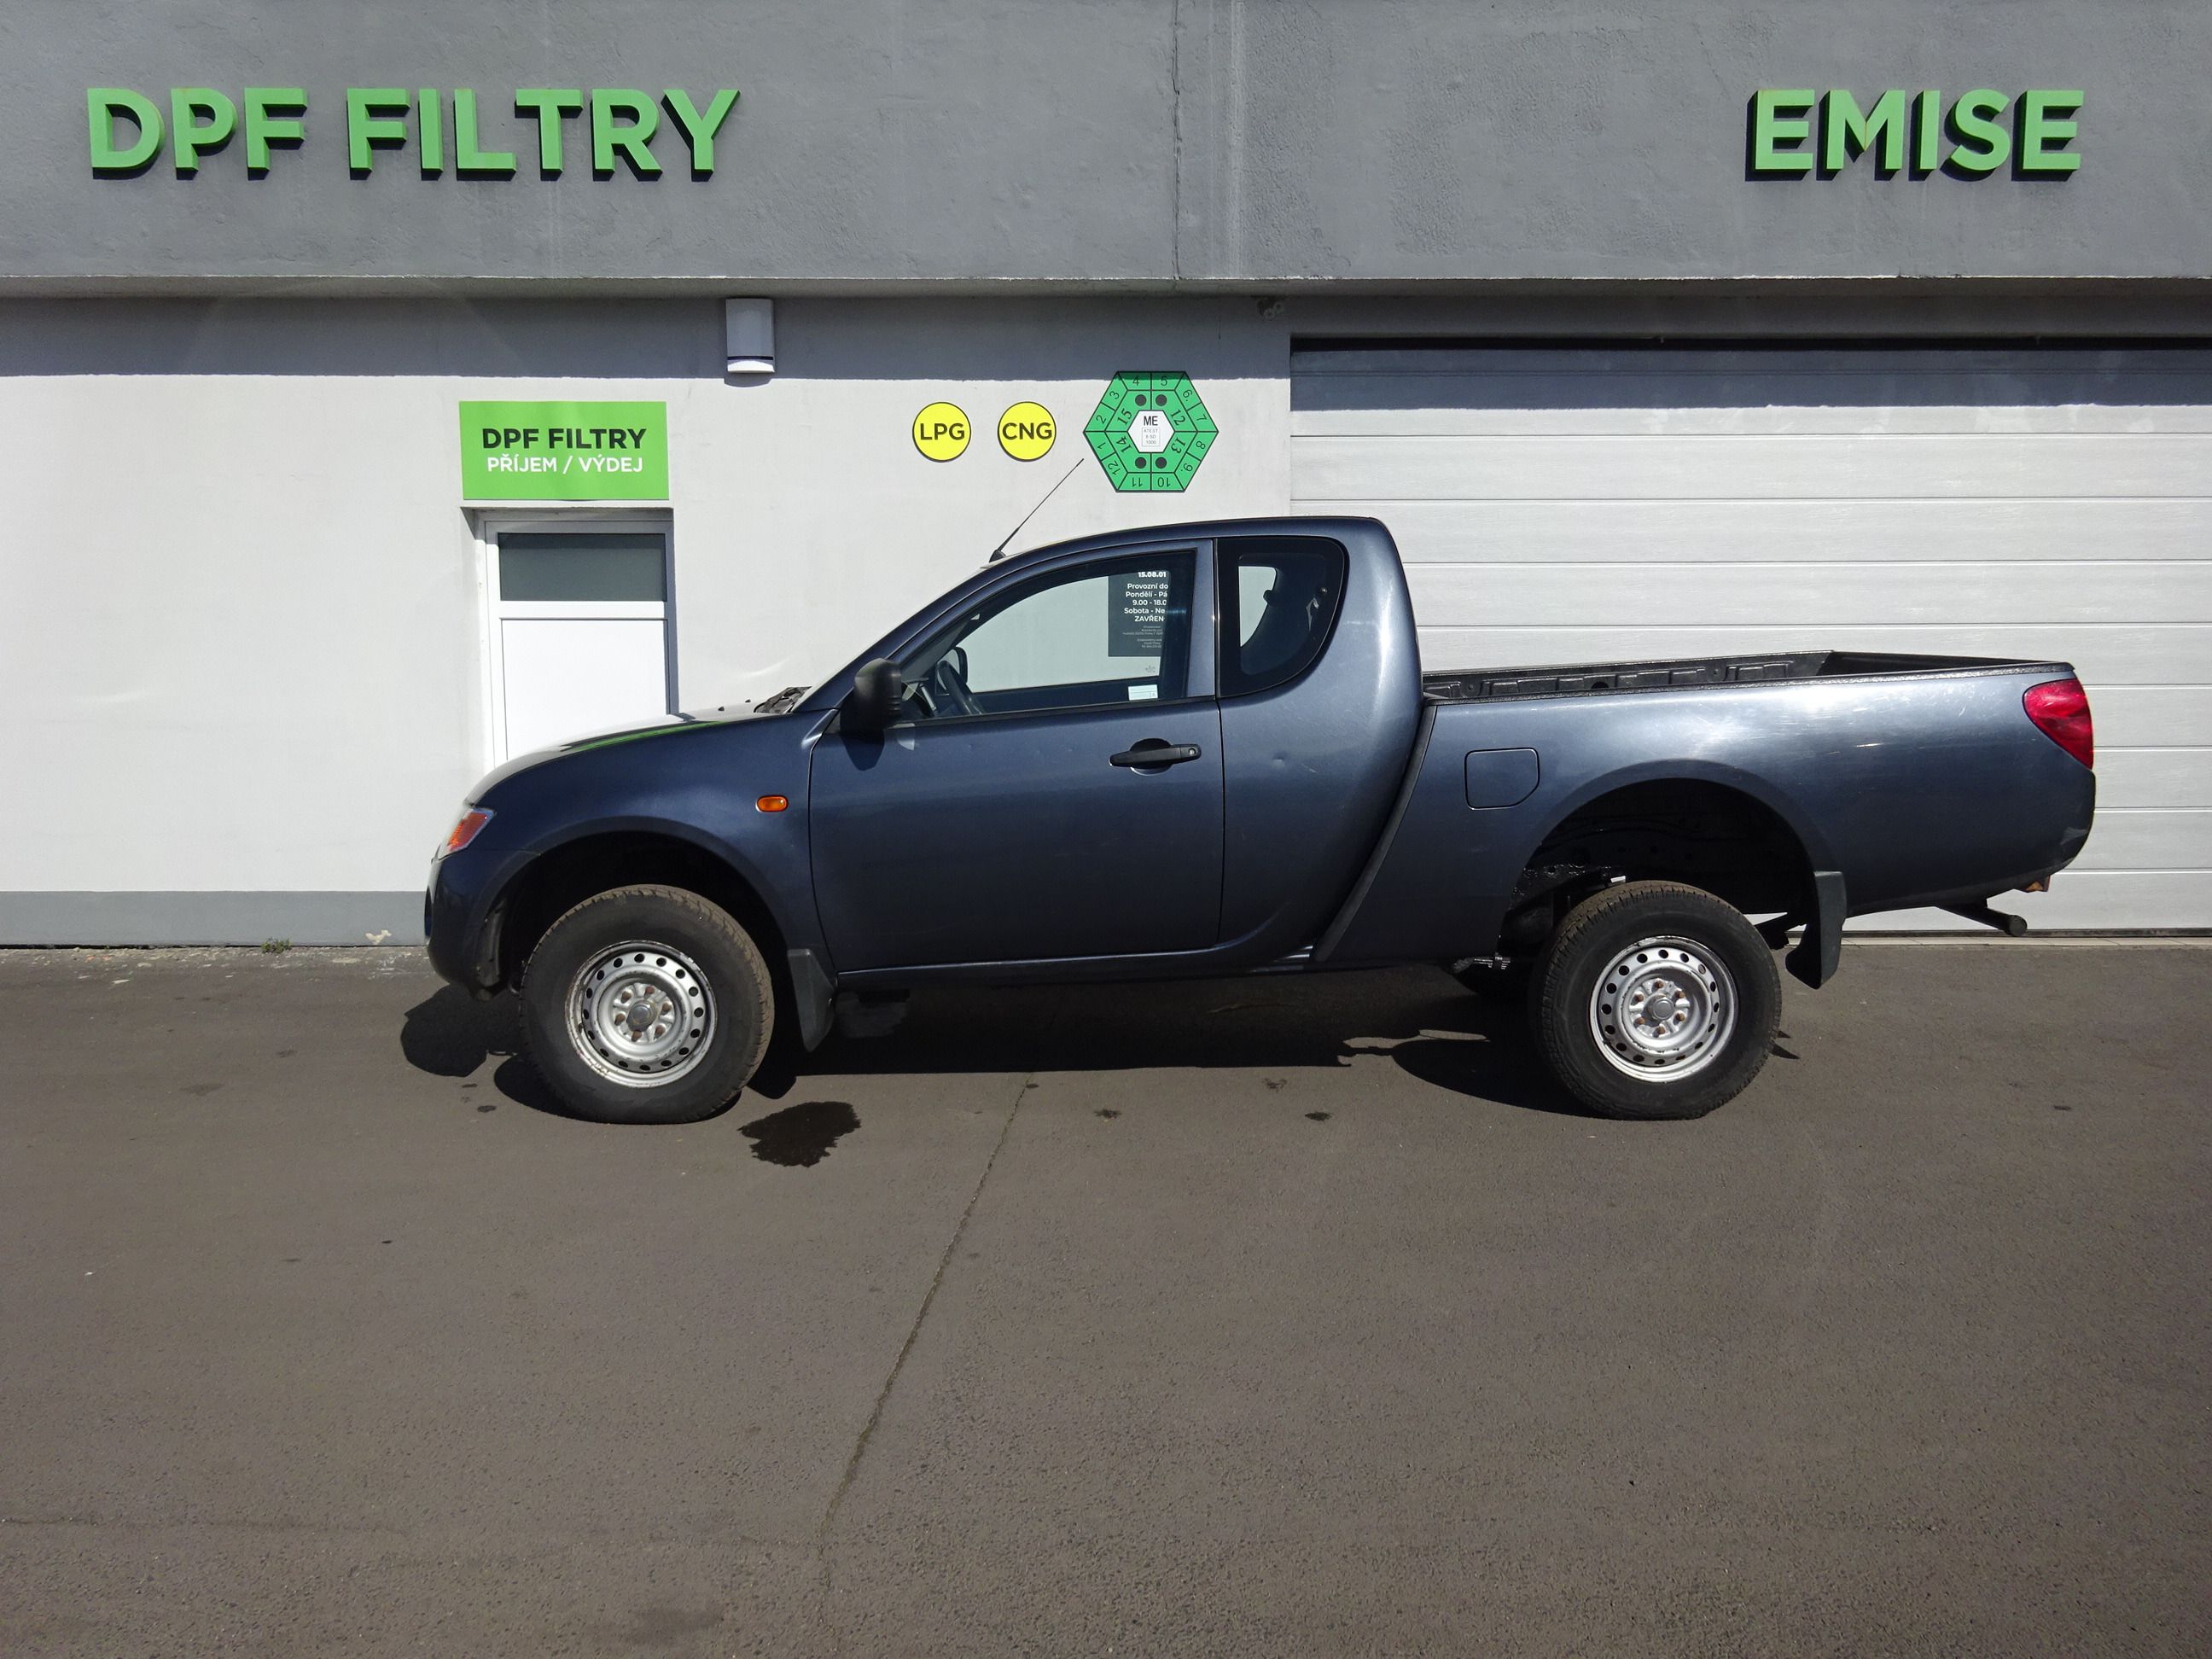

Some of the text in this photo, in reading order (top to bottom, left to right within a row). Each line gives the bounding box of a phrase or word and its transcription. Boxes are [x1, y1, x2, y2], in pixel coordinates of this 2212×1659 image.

[87, 87, 740, 172] DPF FILTRY
[1751, 88, 2084, 172] EMISE
[1132, 375, 1140, 386] 4
[1161, 375, 1167, 386] 5
[1109, 390, 1120, 399] 3
[1096, 415, 1107, 424] 2
[1117, 408, 1132, 425] 15
[1144, 416, 1158, 426] ME
[1170, 409, 1185, 426] 12
[482, 428, 647, 449] DPF FILTRY
[920, 422, 965, 440] LPG
[1002, 422, 1052, 440] CNG
[1097, 441, 1106, 450] 1
[1116, 436, 1132, 453] 14
[1171, 437, 1185, 453] 13
[1196, 440, 1206, 449] 8
[487, 453, 643, 474] PŘÍJEM / VÝDEJ
[1108, 460, 1121, 475] 12
[1132, 477, 1143, 487] 11
[1157, 477, 1171, 487] 10
